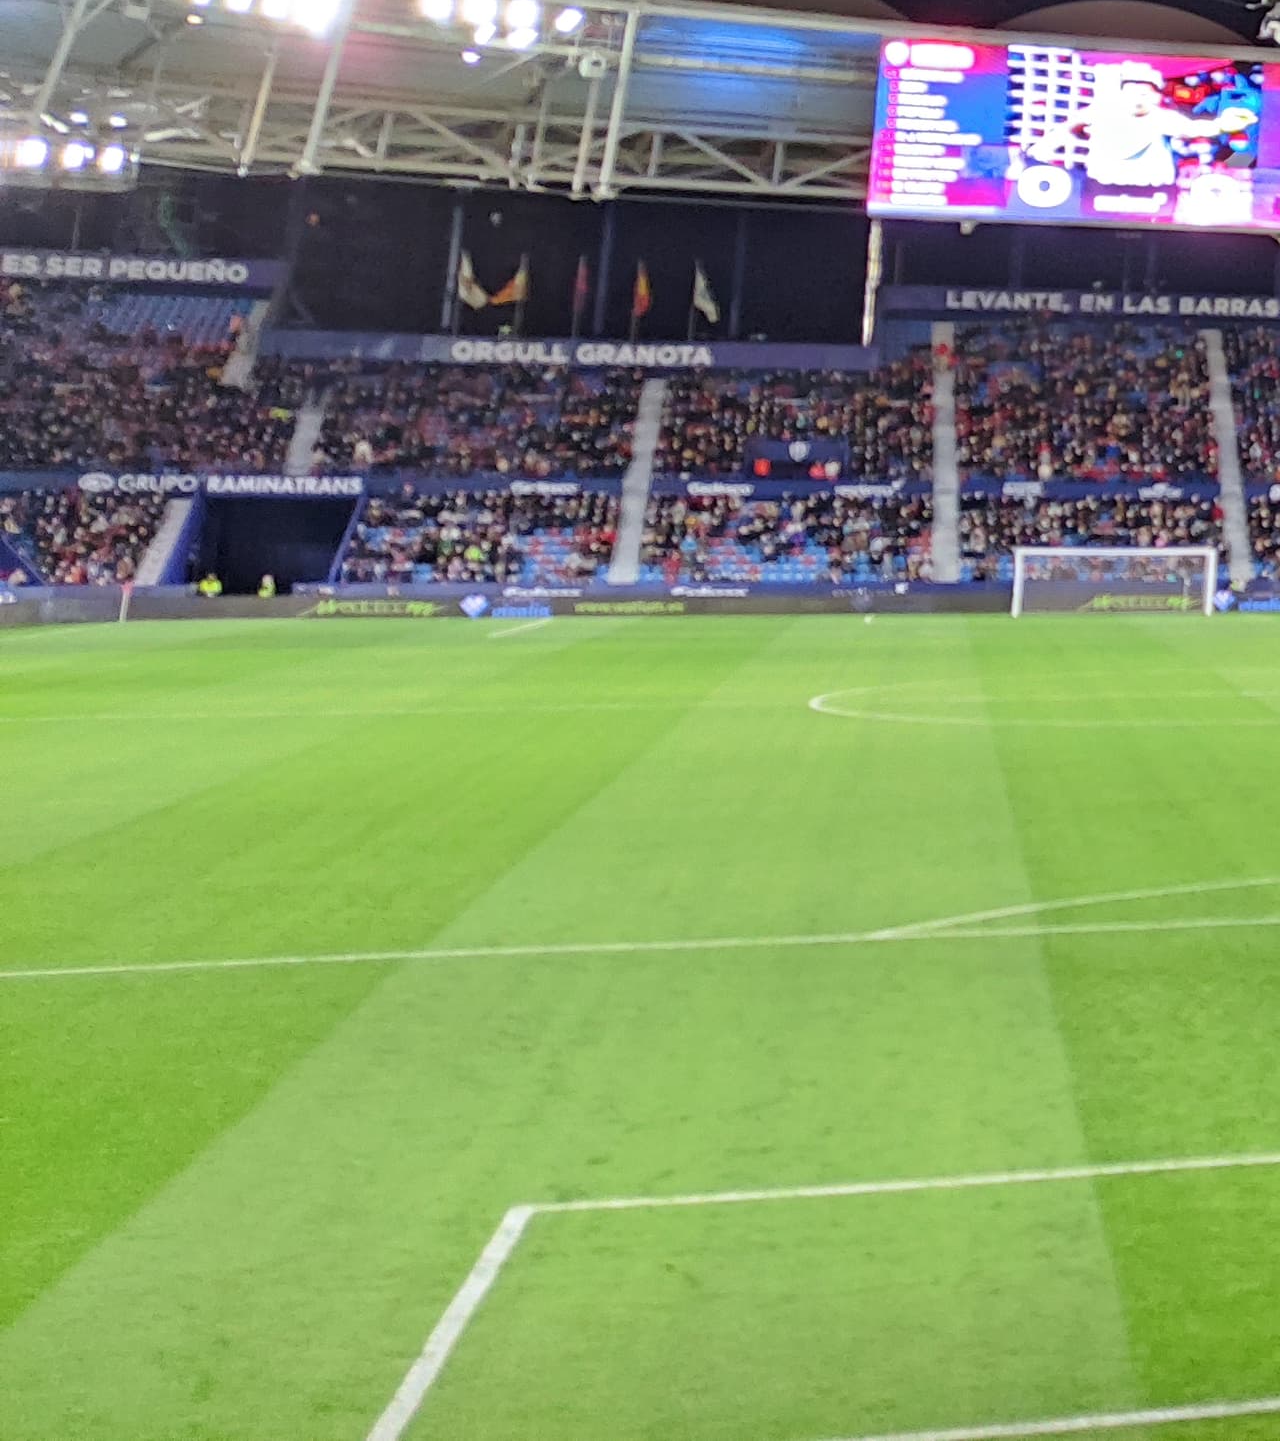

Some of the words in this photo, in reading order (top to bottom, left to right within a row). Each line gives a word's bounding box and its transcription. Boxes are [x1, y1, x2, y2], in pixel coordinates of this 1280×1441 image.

[46, 255, 102, 277] SER
[109, 257, 249, 284] PEQUEÑO
[1079, 293, 1113, 313] EN
[1122, 295, 1170, 314] LAS
[1178, 296, 1279, 317] BARRAS
[451, 341, 569, 366] ORGULL
[576, 343, 713, 366] GRANOTA
[117, 474, 199, 493] GRUPO
